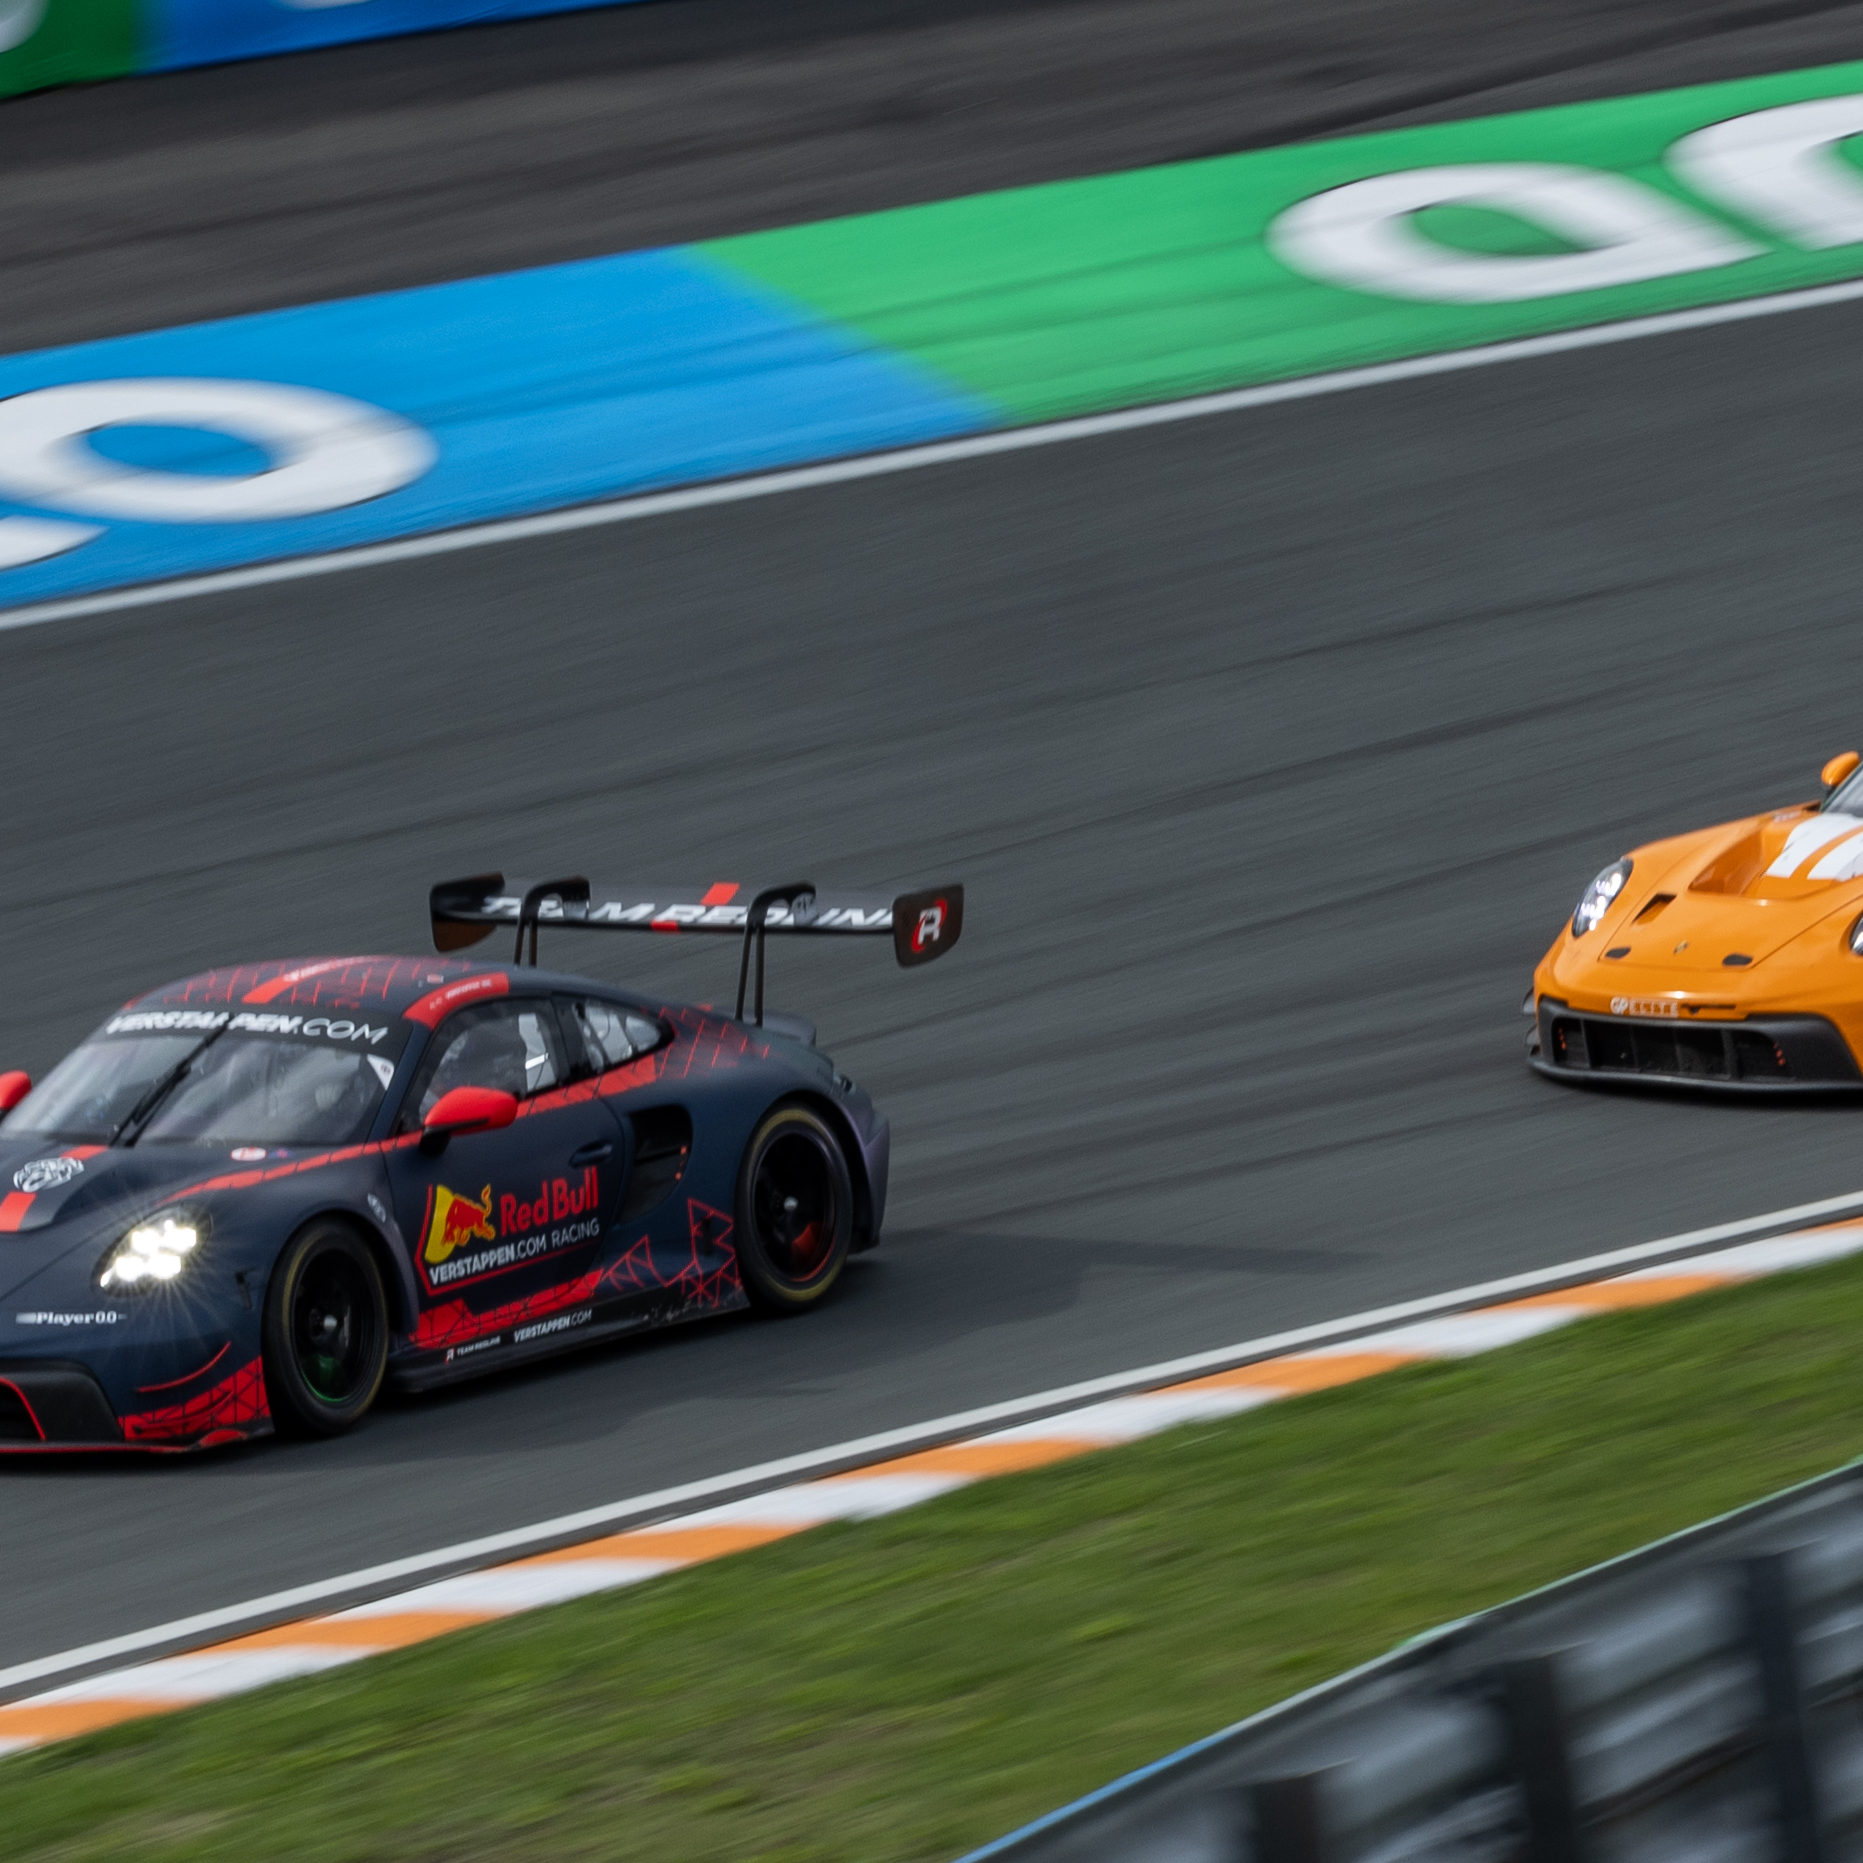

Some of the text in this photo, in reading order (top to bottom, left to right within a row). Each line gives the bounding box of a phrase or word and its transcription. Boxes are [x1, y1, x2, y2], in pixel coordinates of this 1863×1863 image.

[652, 902, 893, 926] REDIN
[106, 1010, 389, 1045] VERSTAPPEN.COM
[500, 1165, 599, 1236] Red Bull
[429, 1217, 600, 1285] VERSTAPPEN.COM RACING
[513, 1308, 592, 1343] VERSTAPPEN.COM
[456, 1344, 474, 1357] TEAM
